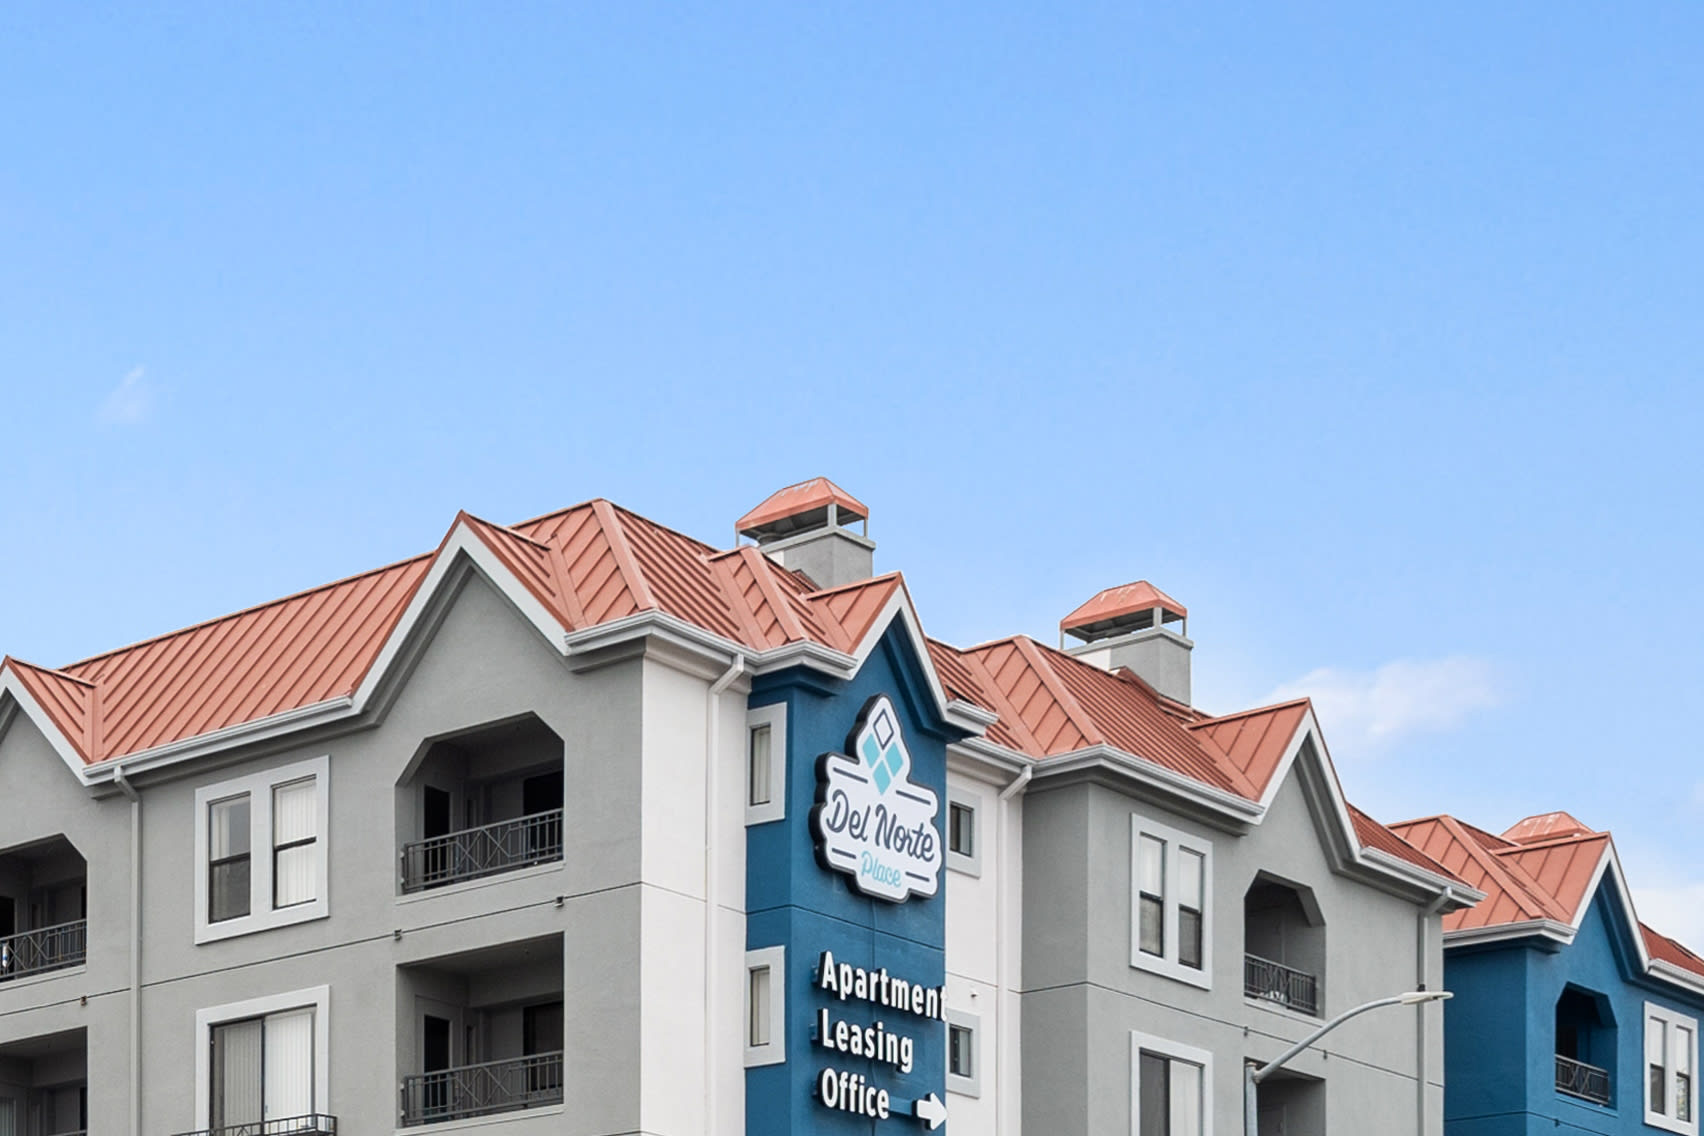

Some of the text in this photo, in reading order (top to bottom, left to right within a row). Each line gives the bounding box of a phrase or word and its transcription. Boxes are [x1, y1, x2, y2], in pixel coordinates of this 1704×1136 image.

[826, 789, 935, 862] Del Norte
[861, 850, 902, 888] Place
[821, 950, 947, 1022] Apartment
[822, 1008, 913, 1074] Leasing
[821, 1067, 890, 1120] Office
